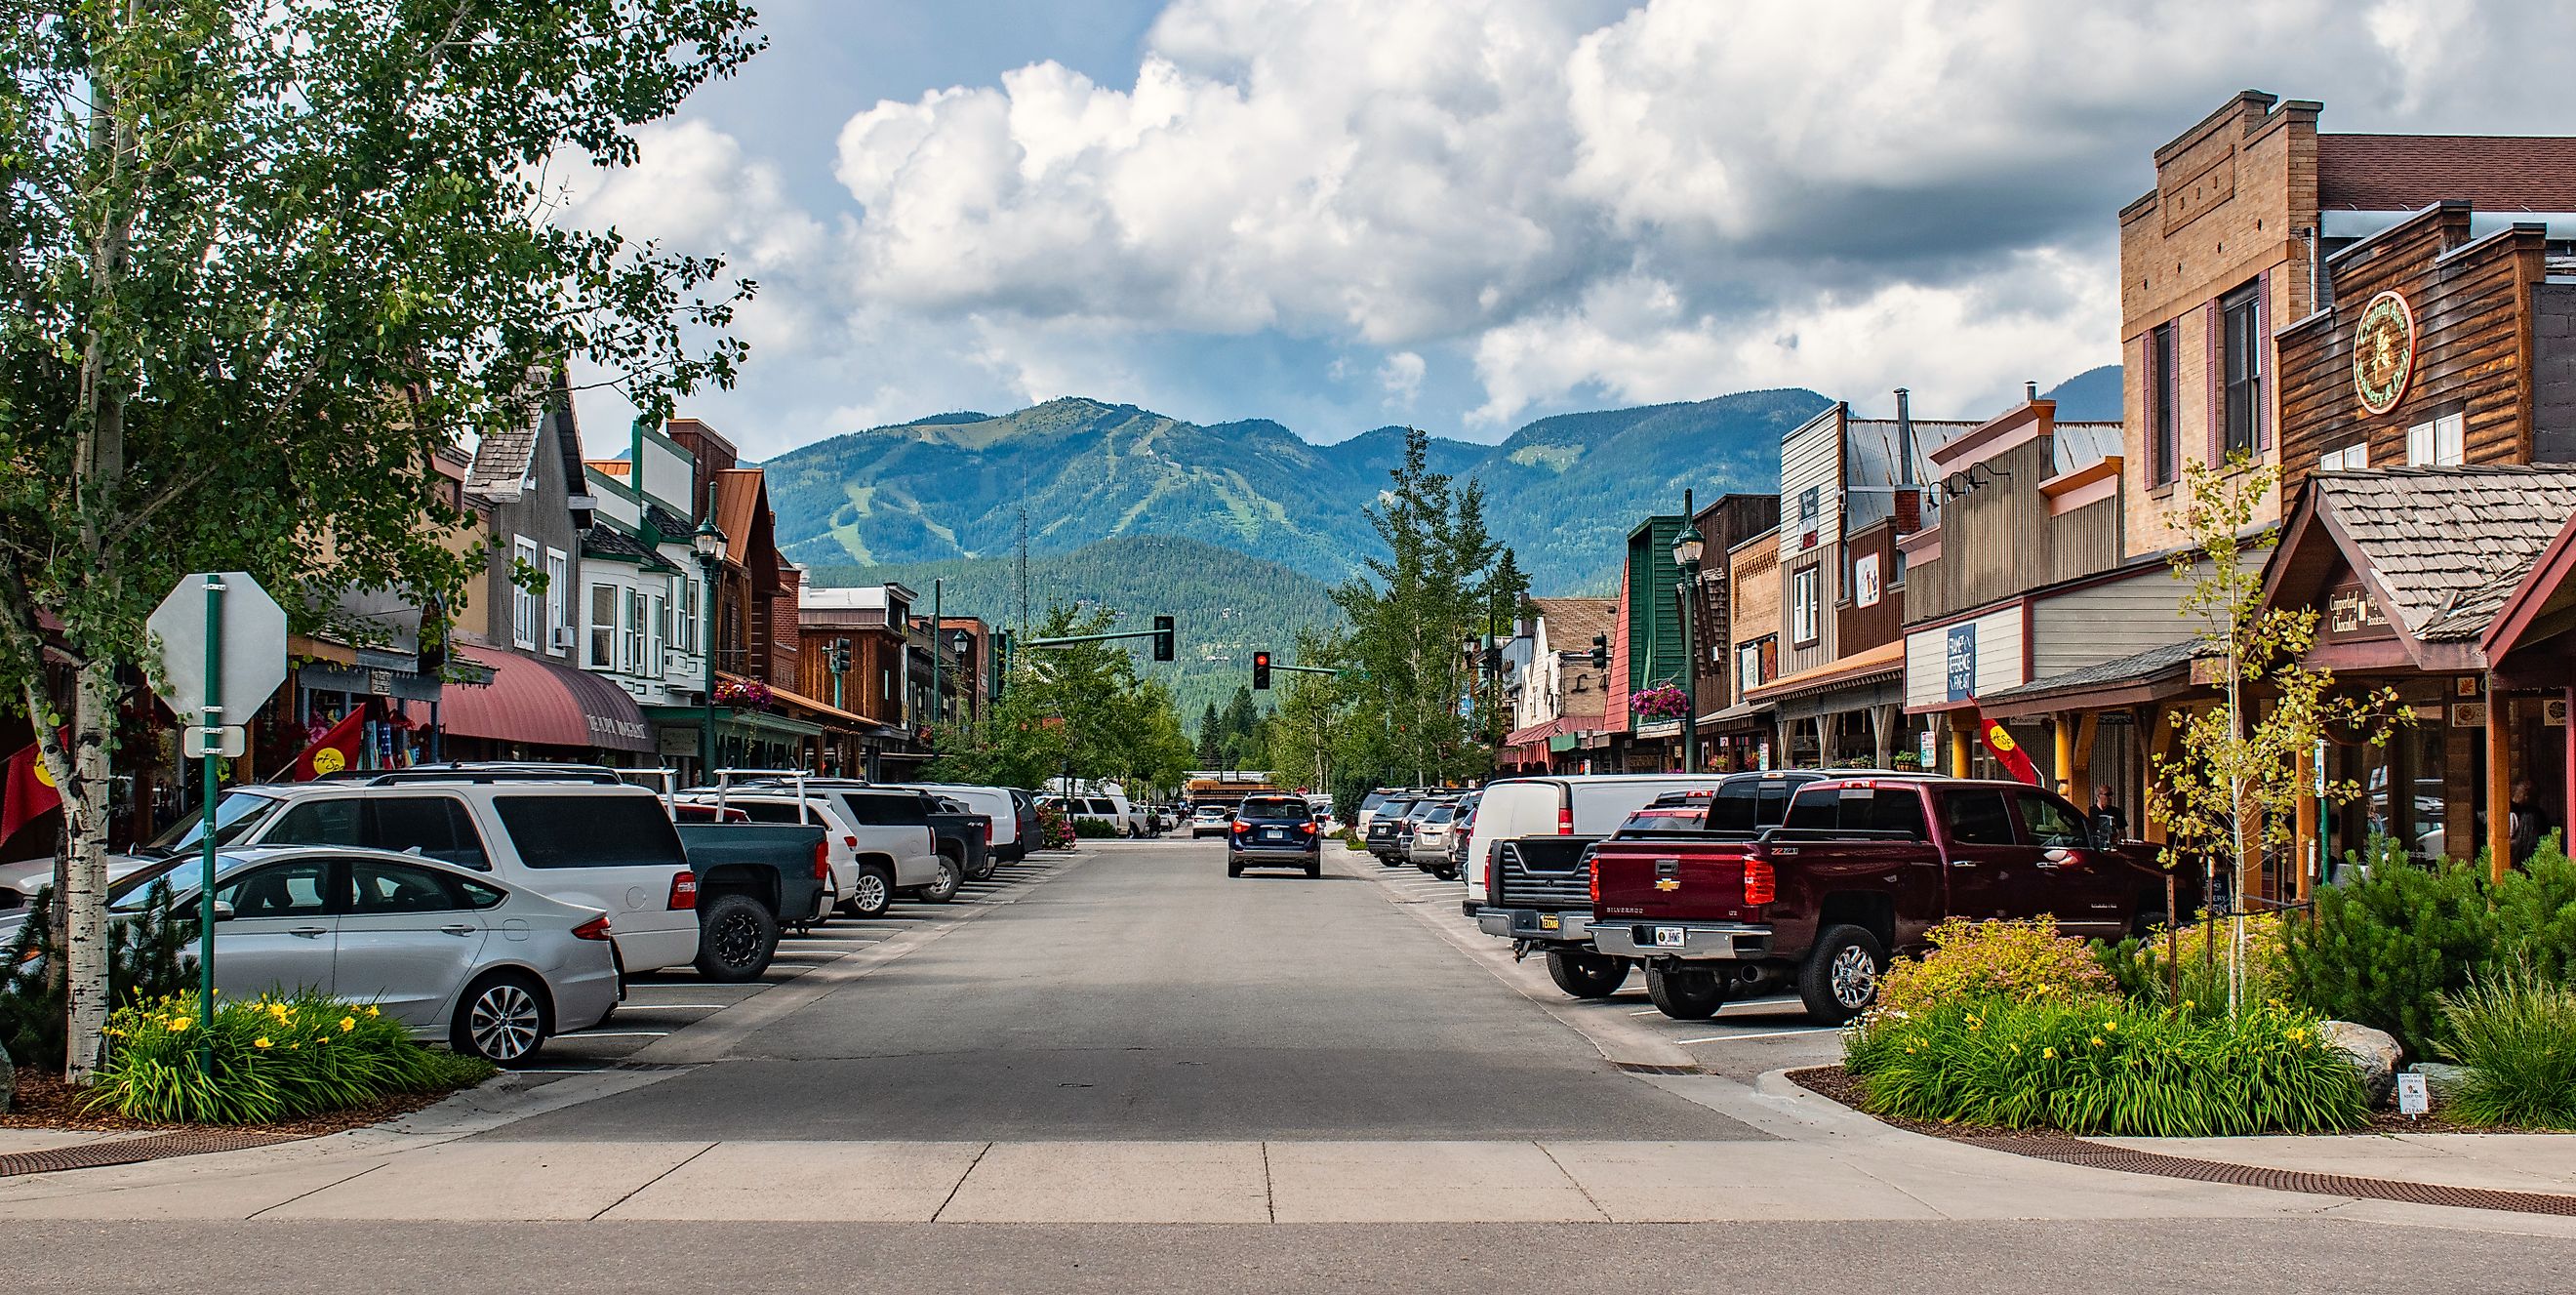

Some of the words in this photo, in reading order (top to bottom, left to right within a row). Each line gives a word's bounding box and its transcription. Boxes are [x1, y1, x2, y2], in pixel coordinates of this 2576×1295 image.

[2359, 300, 2390, 344] Central
[2390, 301, 2406, 339] Ave.
[2356, 359, 2384, 407] Bakery
[2385, 383, 2394, 401] &
[2393, 347, 2409, 391] Deli
[2329, 590, 2358, 615] Copperleaf
[2332, 614, 2358, 633] Chocolat
